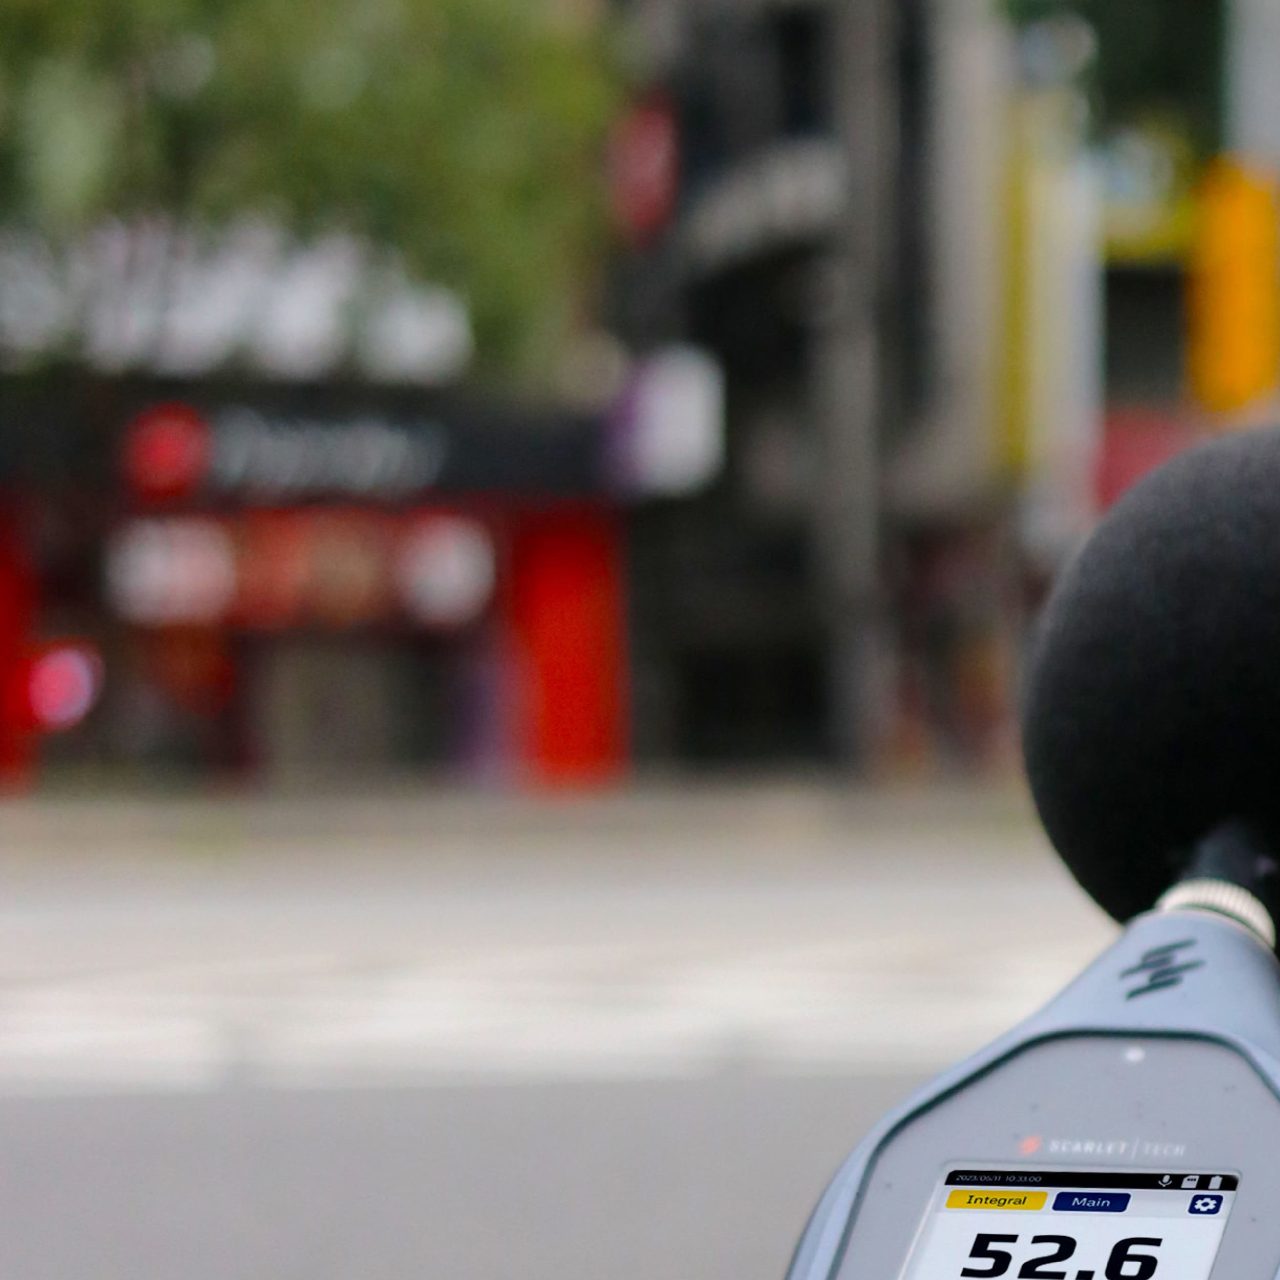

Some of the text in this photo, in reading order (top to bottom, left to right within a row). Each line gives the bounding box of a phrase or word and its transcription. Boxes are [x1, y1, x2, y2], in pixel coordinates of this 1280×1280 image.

[1050, 1139, 1128, 1155] SCARLET
[966, 1195, 1028, 1207] Integral
[1071, 1197, 1111, 1207] Main
